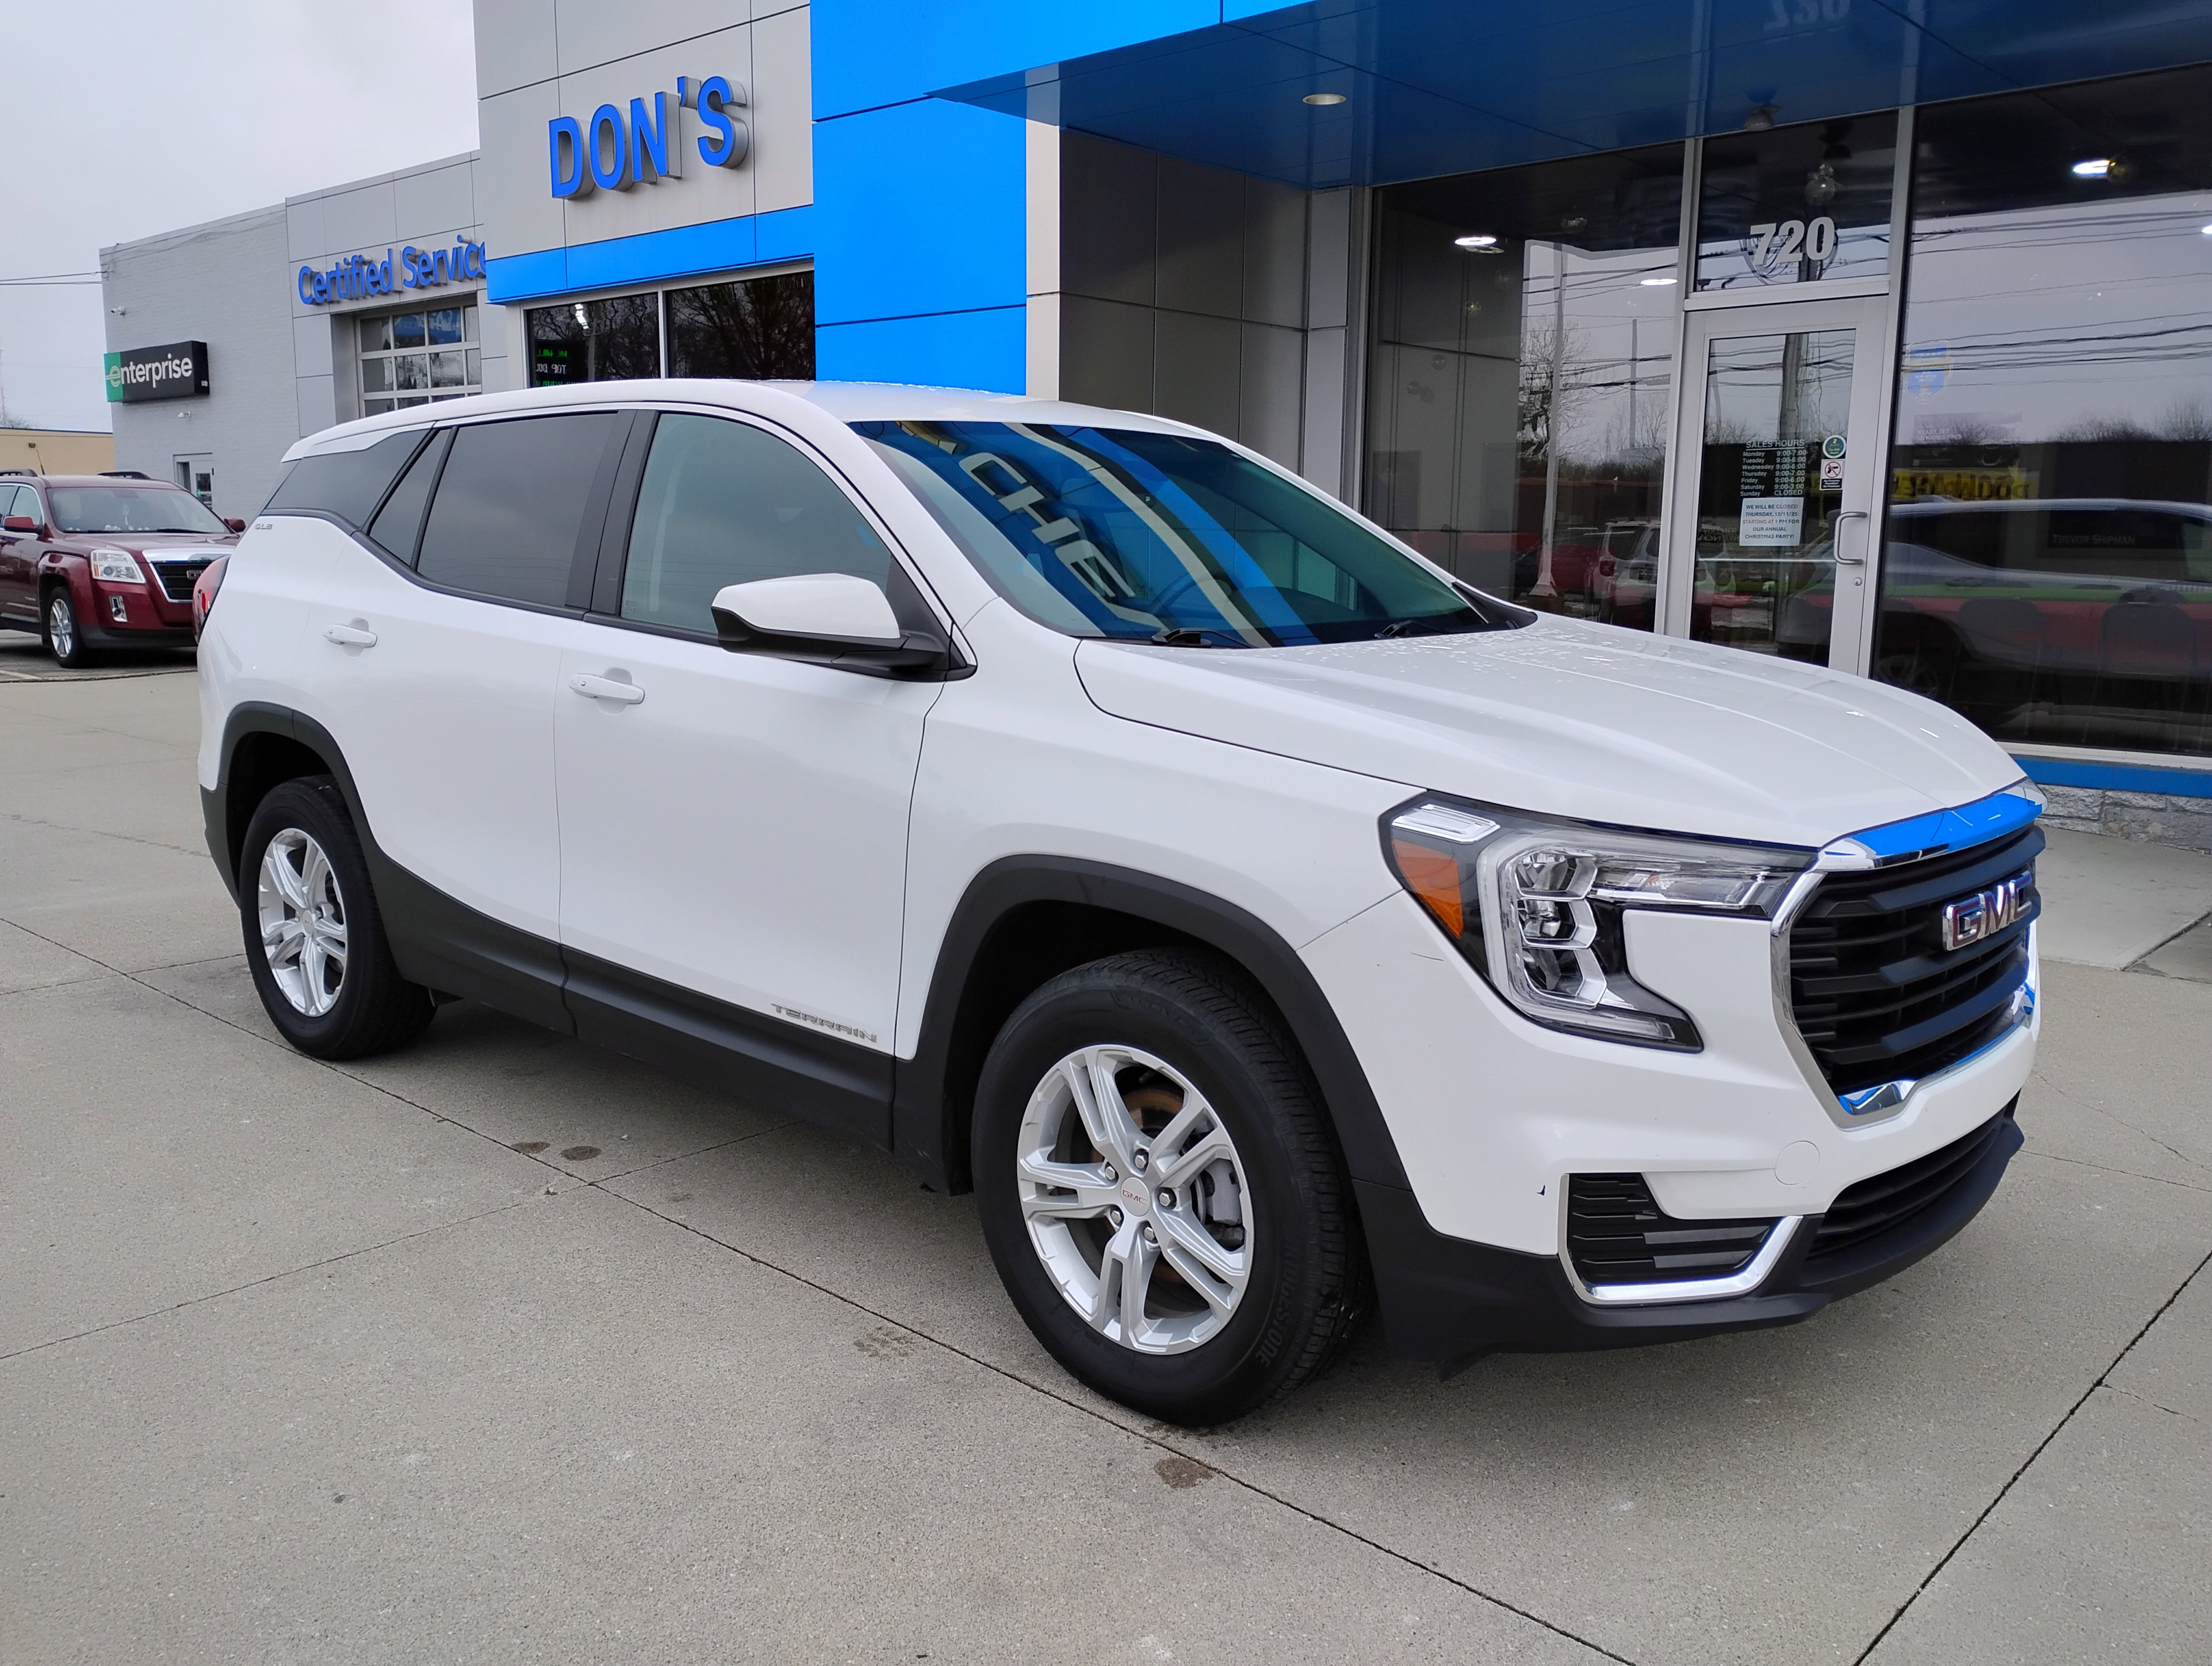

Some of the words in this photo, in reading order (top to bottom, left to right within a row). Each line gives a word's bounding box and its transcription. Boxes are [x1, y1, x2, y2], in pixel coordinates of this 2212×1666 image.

[548, 75, 748, 199] DON'S
[1750, 217, 1835, 266] 720
[298, 248, 394, 305] Certified
[105, 353, 193, 388] enterprise
[2052, 534, 2089, 544] TREVOR
[2092, 534, 2135, 544] SHIPMAN
[1943, 870, 2032, 951] GMC
[770, 1003, 877, 1043] TERRAIN
[1122, 1189, 1147, 1205] GMC
